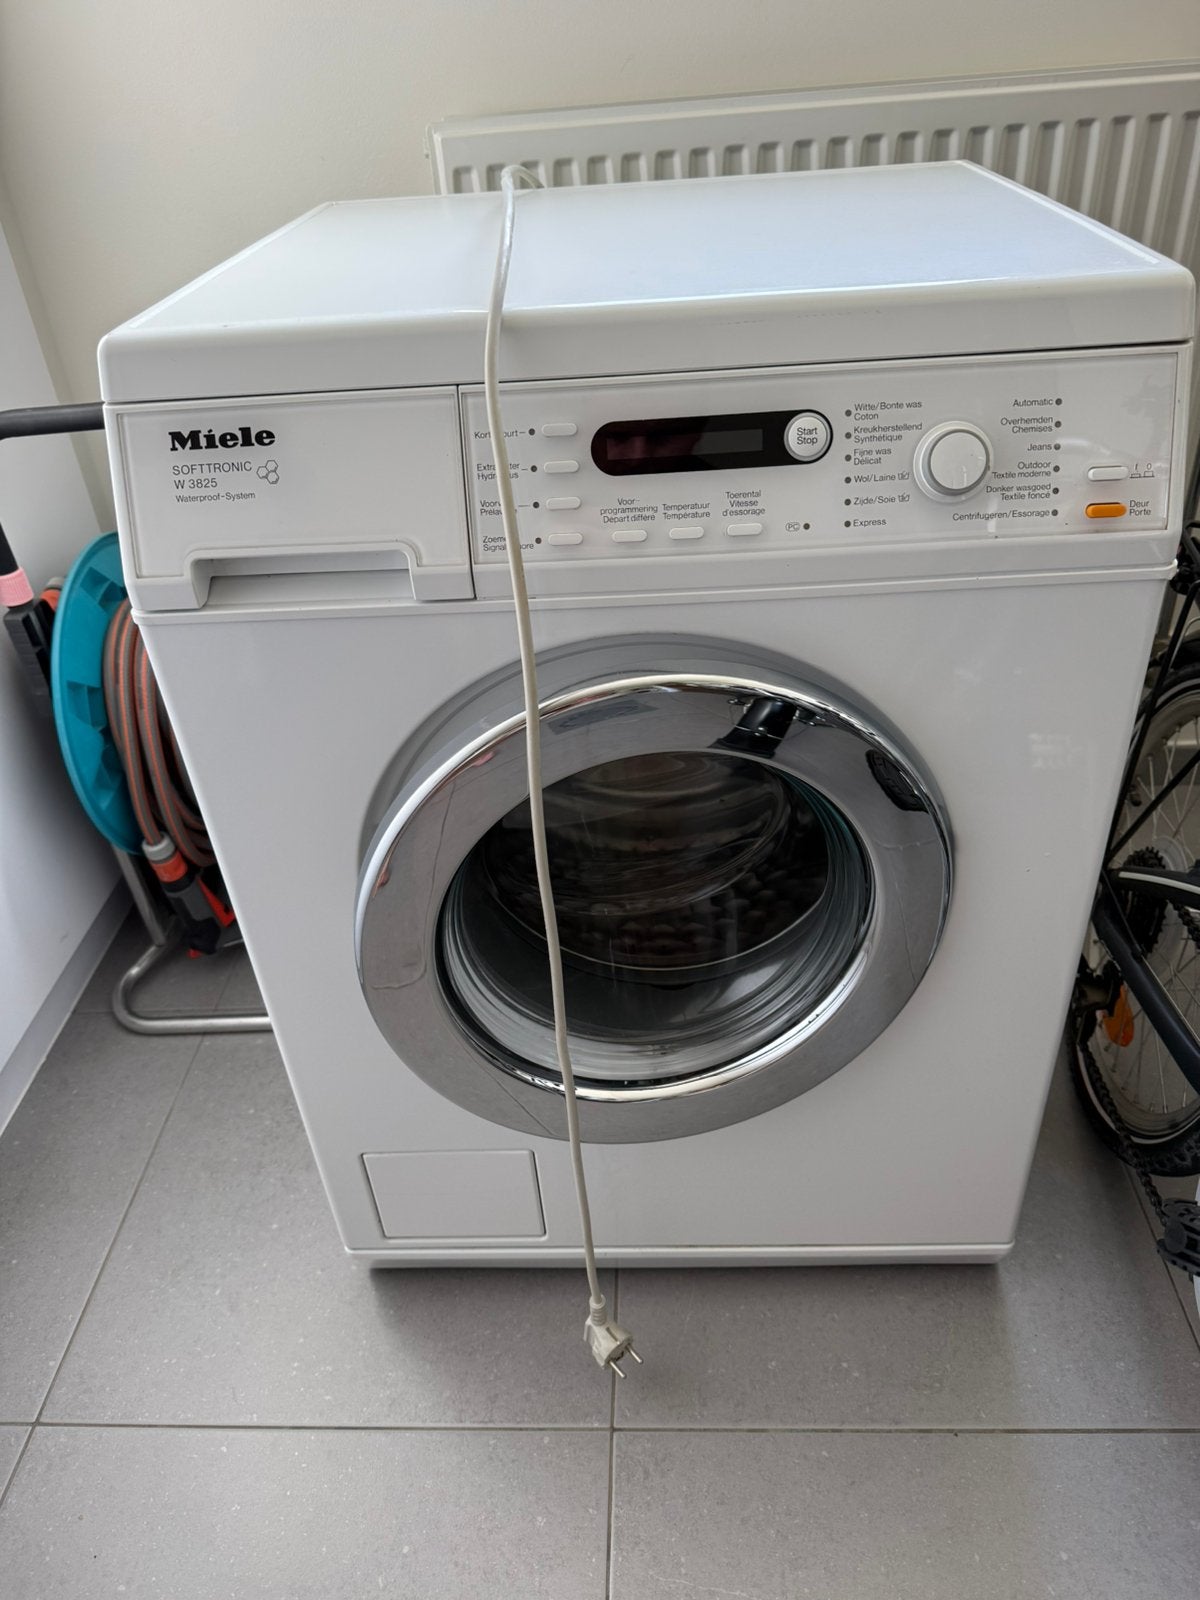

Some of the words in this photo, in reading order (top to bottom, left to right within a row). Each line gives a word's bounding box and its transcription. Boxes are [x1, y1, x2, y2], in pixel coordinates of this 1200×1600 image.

[854, 402, 904, 411] Witte/Bonte
[1013, 398, 1053, 407] Automatic
[854, 412, 878, 421] Coton
[1000, 416, 1053, 426] Overhemden
[796, 427, 818, 436] Start
[854, 423, 922, 434] Kreukherstellend
[1012, 424, 1053, 434] Chemises
[168, 426, 276, 451] Miele
[474, 430, 518, 439] Kortourt
[796, 436, 818, 446] Stop
[854, 448, 874, 457] Fijne
[1027, 444, 1052, 452] Jeans
[172, 461, 252, 476] SOFTTRONIC
[1017, 461, 1051, 470] Outdoor
[477, 472, 519, 481] Hydrus
[854, 473, 896, 483] Wol/Laine
[992, 472, 1016, 480] Textile
[1017, 470, 1052, 478] moderne
[174, 479, 185, 490] W
[188, 478, 218, 489] 3825
[986, 485, 1014, 493] Donker
[1016, 484, 1051, 492] wasgoed
[175, 492, 256, 503] Waterproof-System
[725, 490, 762, 498] Toerental
[1001, 492, 1026, 500] Textile
[730, 500, 758, 508] Vitesse
[854, 496, 896, 506] Zijde/Soie
[1130, 500, 1150, 508] Deur
[600, 505, 658, 515] programmering
[662, 502, 710, 511] Temperatuur
[722, 507, 766, 516] d'essorage
[952, 509, 1050, 521] Centrifugeren/Essorage
[1129, 508, 1152, 516] Porte
[853, 518, 887, 527] Express
[482, 536, 507, 544] Zoeme
